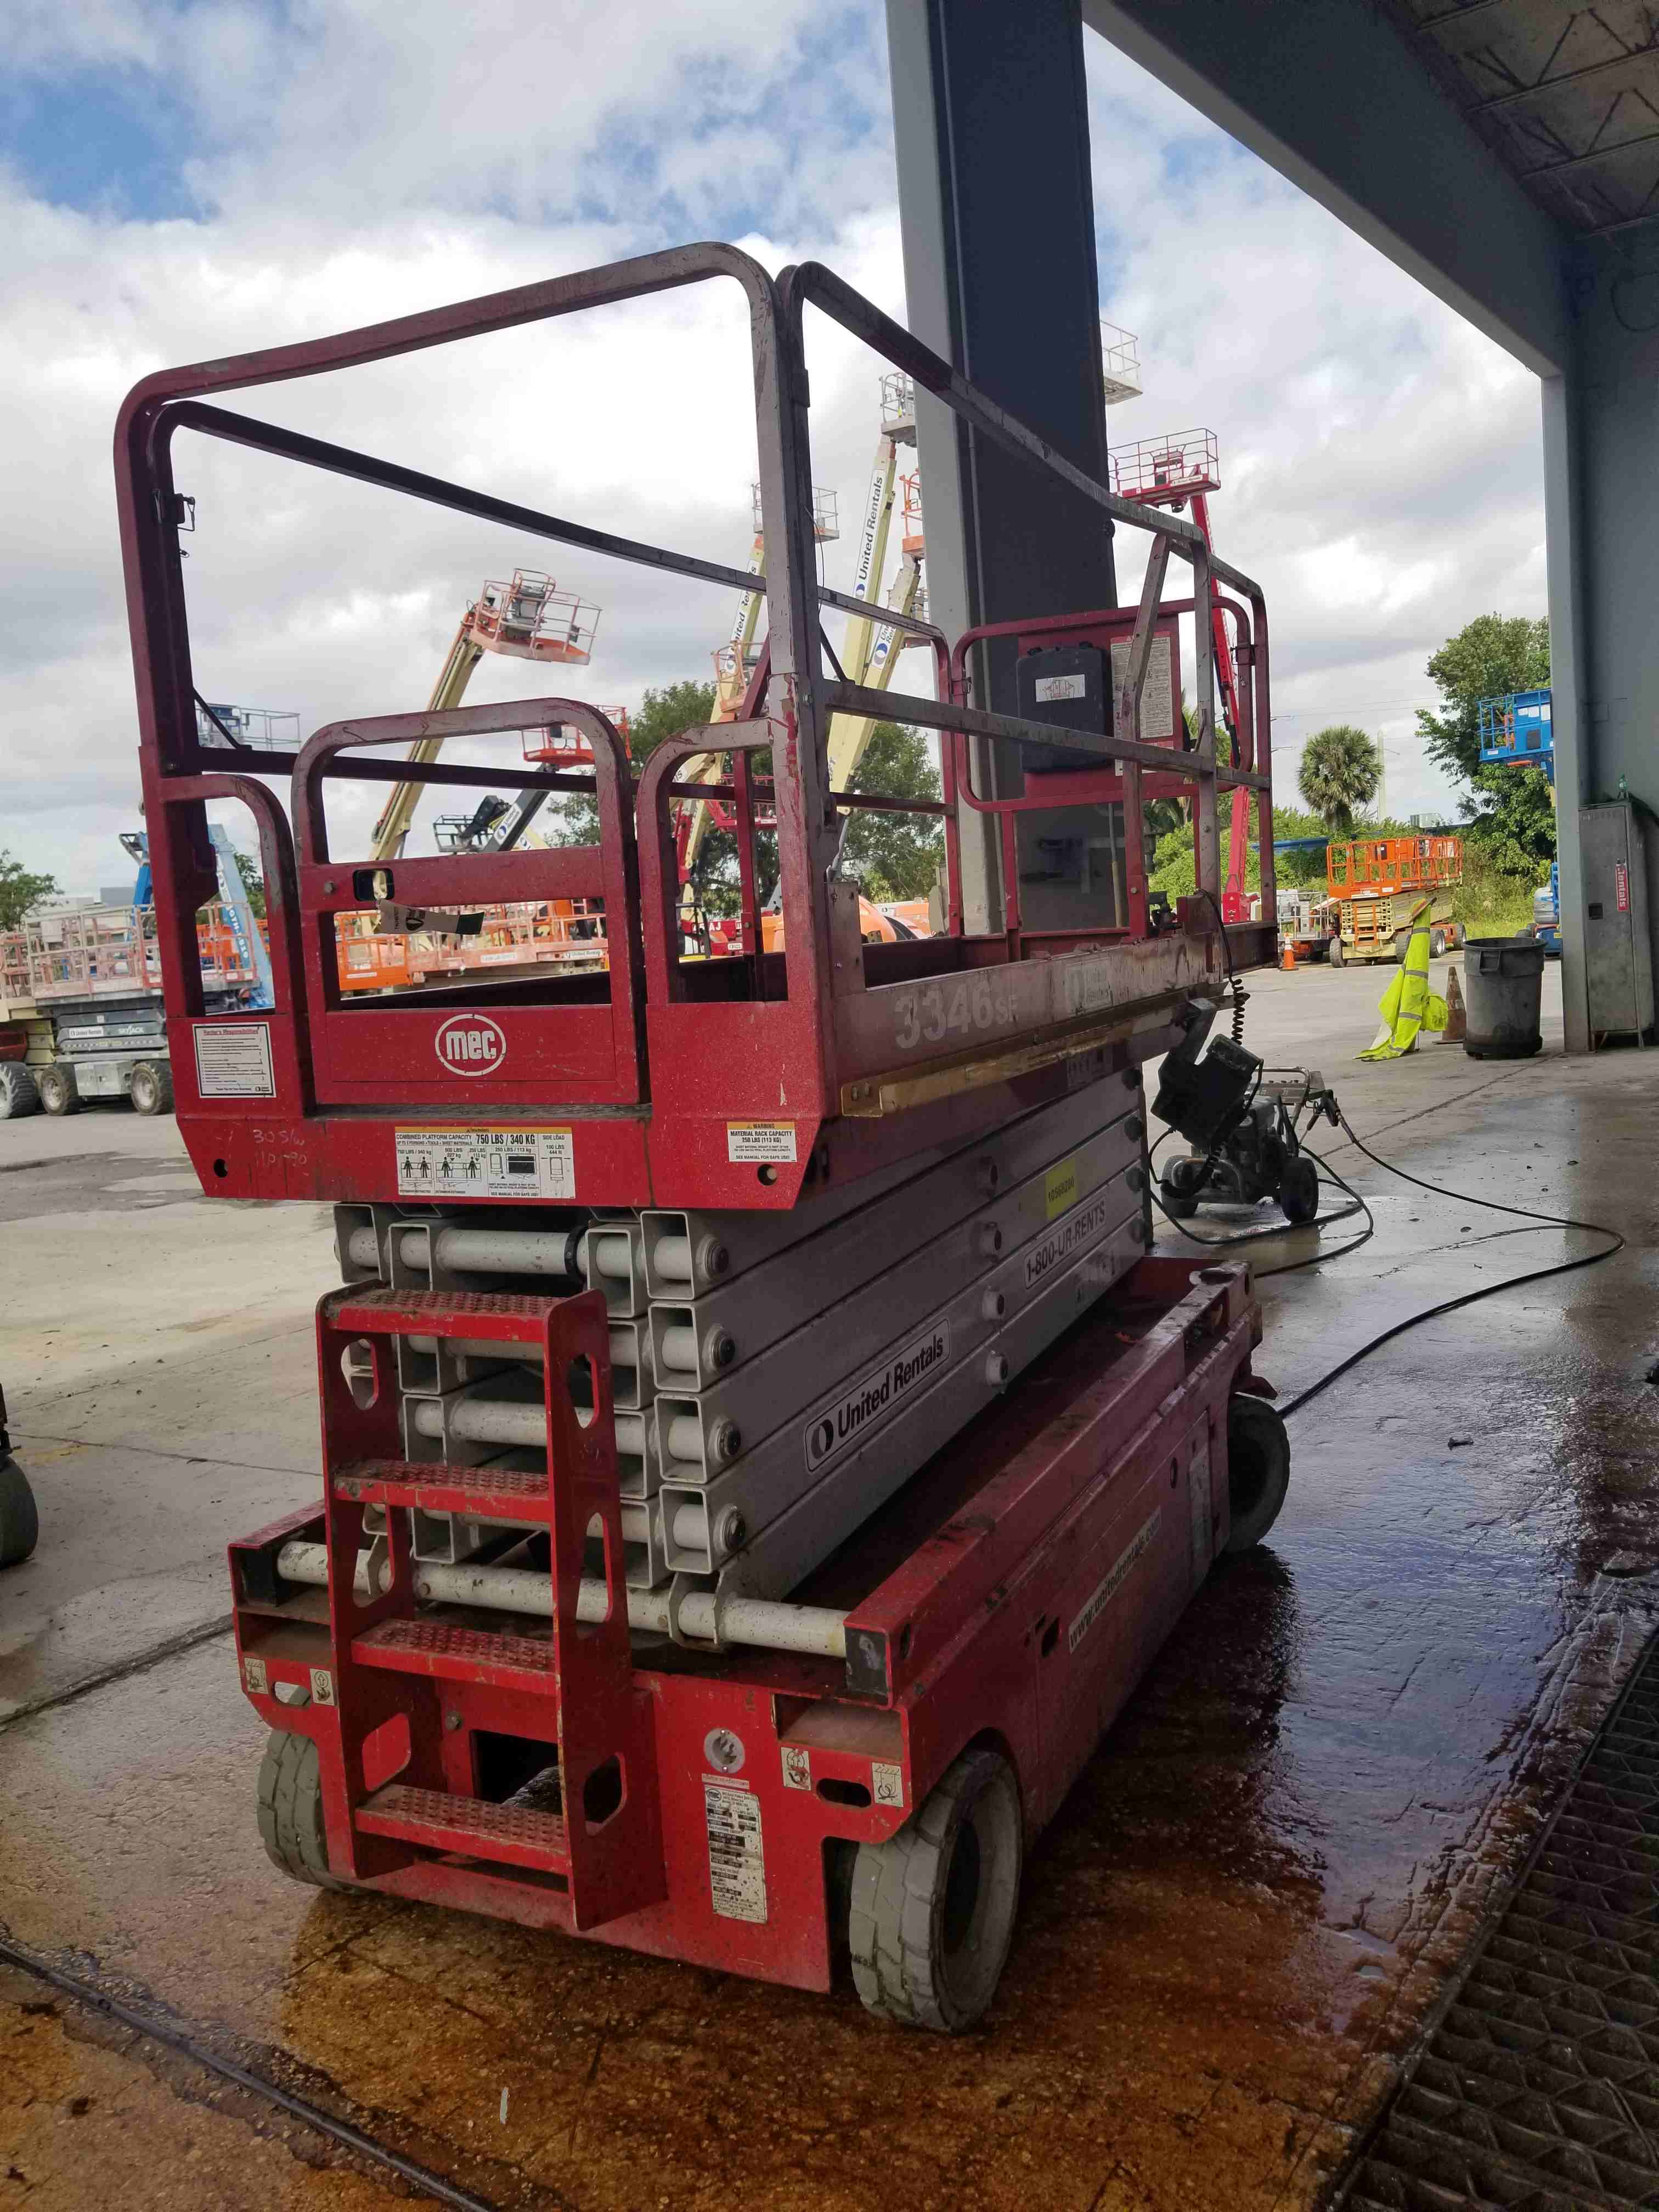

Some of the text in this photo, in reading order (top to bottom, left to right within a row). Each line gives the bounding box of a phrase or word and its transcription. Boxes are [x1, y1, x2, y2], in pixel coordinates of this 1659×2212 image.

[859, 476, 883, 580] United Rentals
[476, 1134, 489, 1144] 750
[491, 1134, 504, 1144] LBS
[510, 1135, 523, 1144] 340
[526, 1135, 535, 1144] KG
[1026, 1199, 1105, 1282] 1-800-UR-RENTS
[838, 1334, 943, 1438] United Rentals
